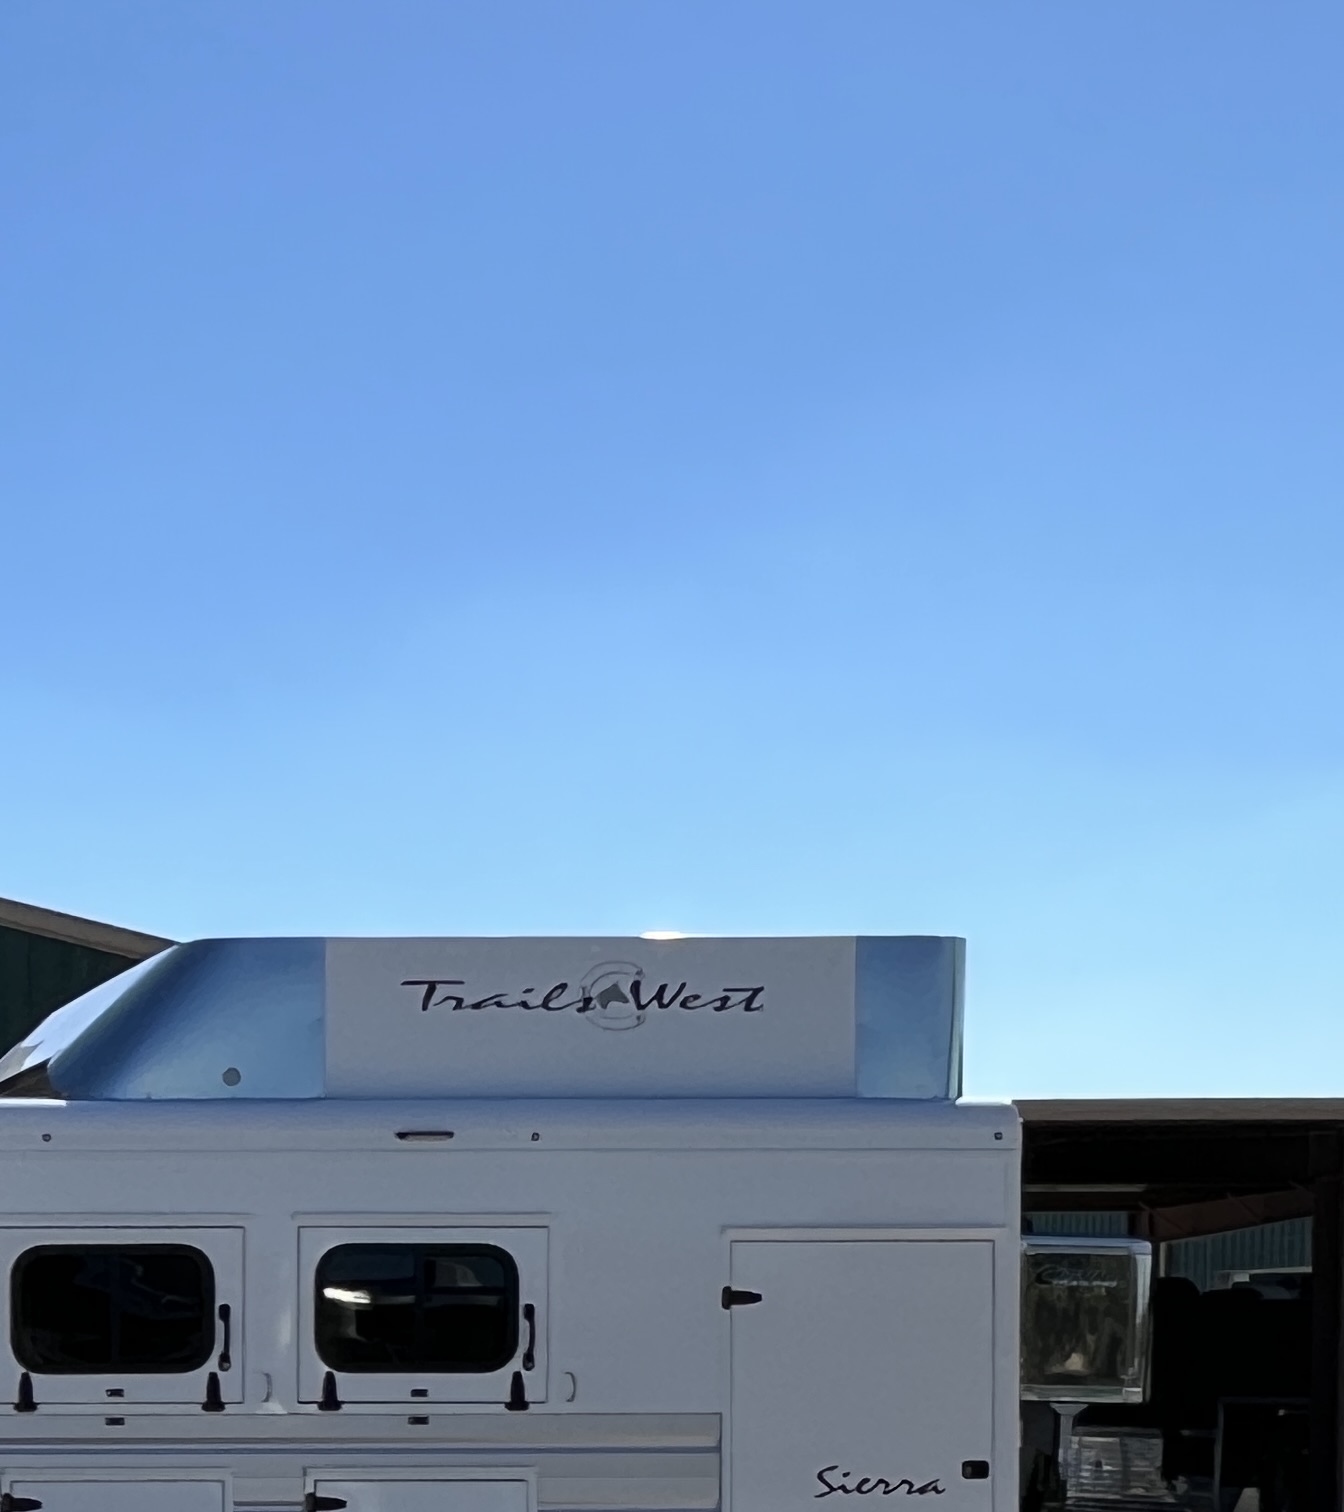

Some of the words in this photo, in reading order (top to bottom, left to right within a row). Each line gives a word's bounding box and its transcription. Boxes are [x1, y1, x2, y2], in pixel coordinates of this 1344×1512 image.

[400, 980, 596, 1013] Trails
[630, 980, 765, 1013] West
[814, 1465, 946, 1498] Sierra
